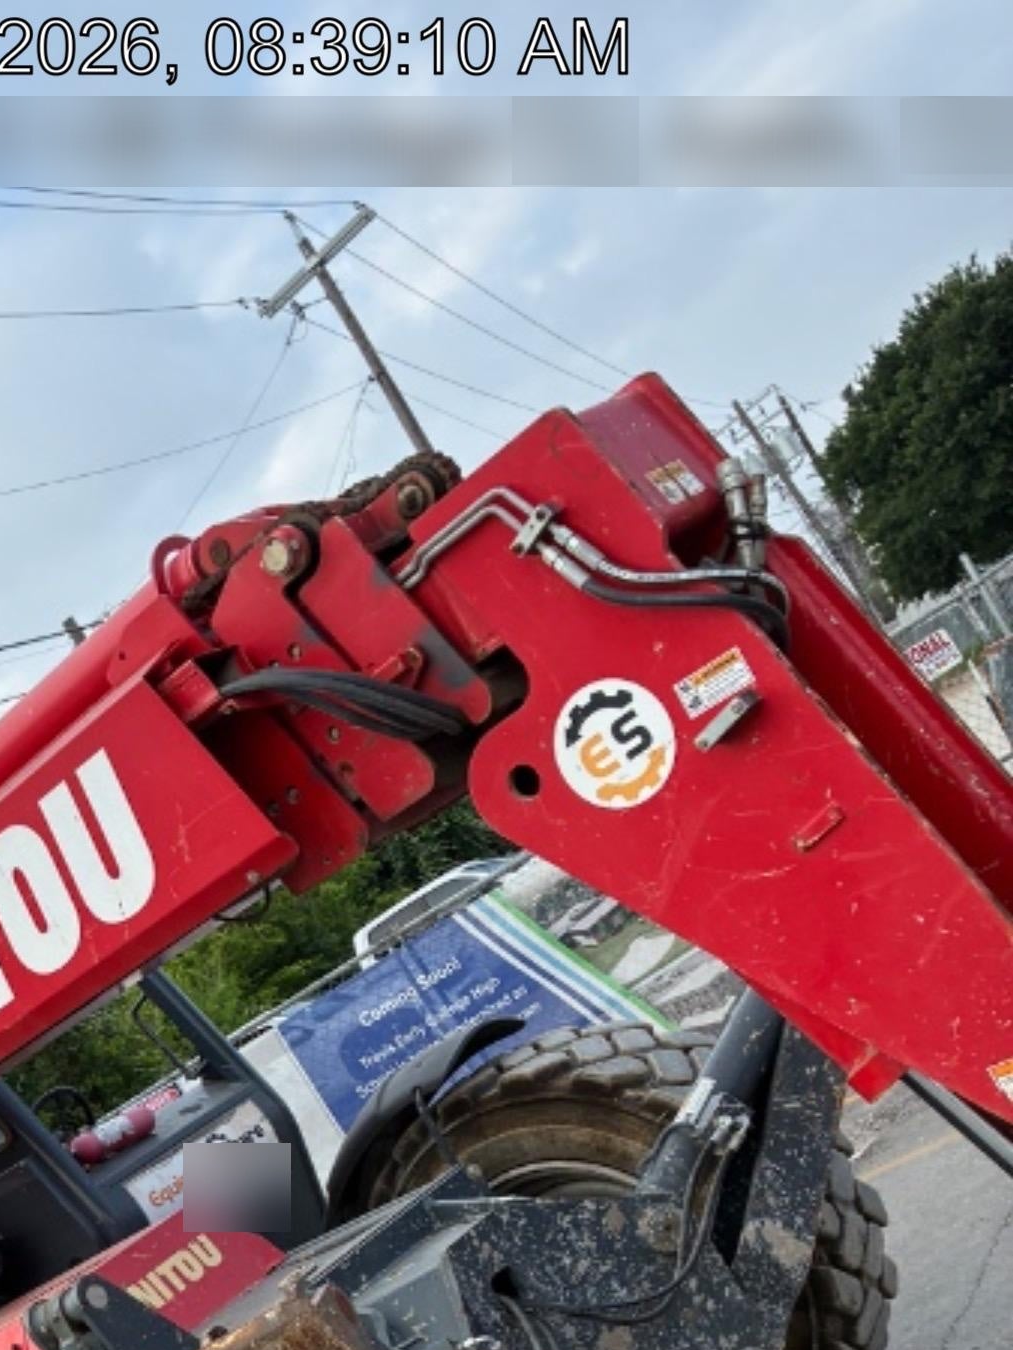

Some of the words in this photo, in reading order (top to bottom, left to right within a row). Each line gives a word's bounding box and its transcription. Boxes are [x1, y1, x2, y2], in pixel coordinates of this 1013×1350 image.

[358, 987, 418, 1026] Coming
[415, 956, 462, 990] Soon!
[469, 977, 501, 1000] High
[126, 1233, 223, 1309] NITOU
